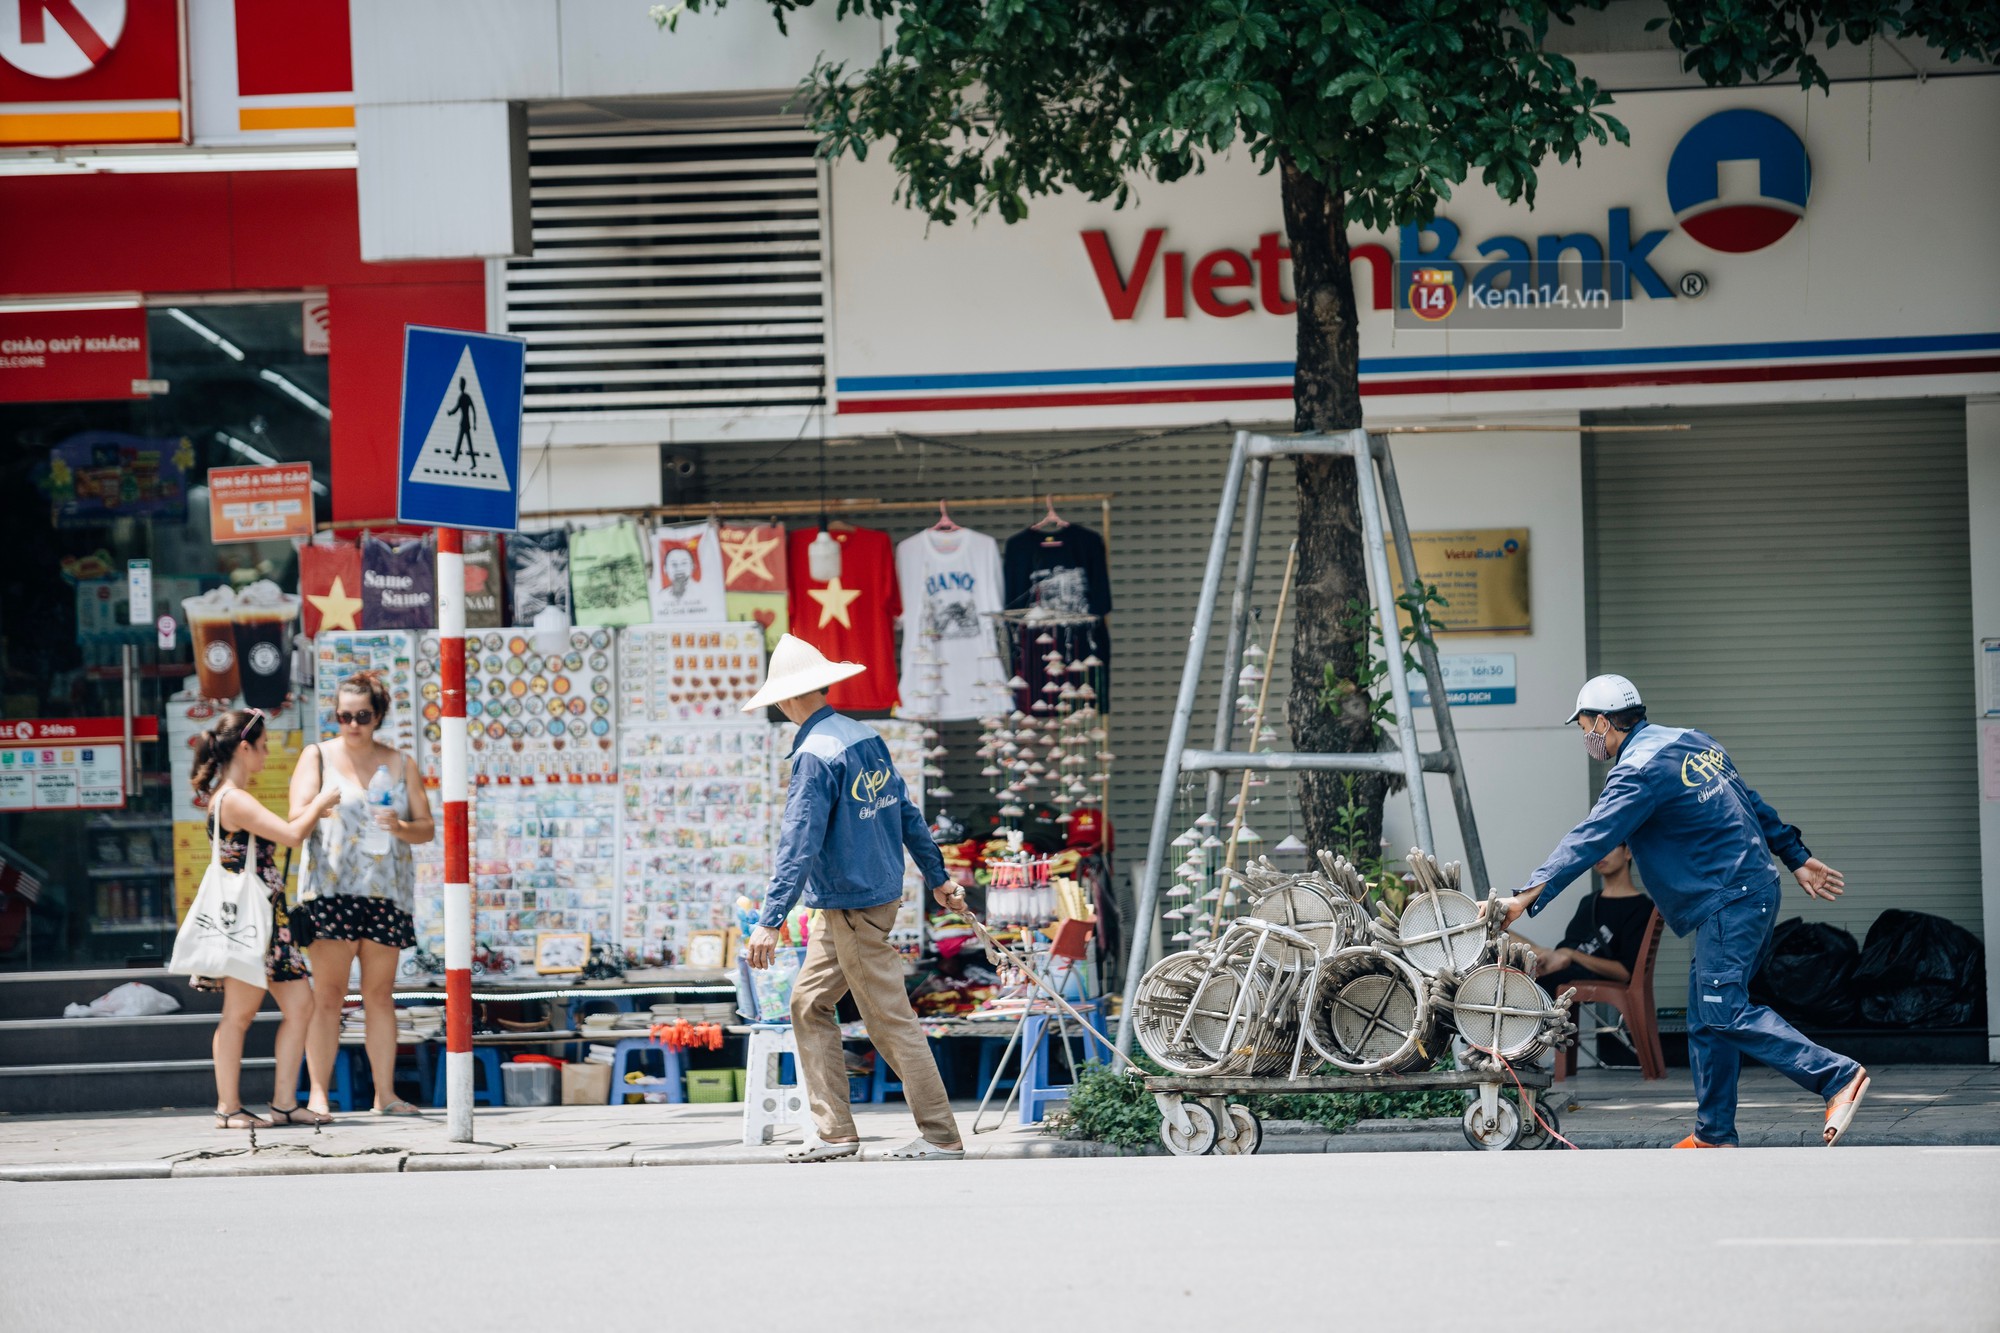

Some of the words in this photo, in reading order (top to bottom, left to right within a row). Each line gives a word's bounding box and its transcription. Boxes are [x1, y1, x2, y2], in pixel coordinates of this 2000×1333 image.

[1080, 207, 1676, 320] VietnBank
[1, 337, 47, 354] CHÀO
[85, 335, 140, 352] KHÁCH
[0, 356, 46, 368] ELCOME
[364, 569, 414, 590] Same
[381, 588, 432, 608] Same
[40, 724, 77, 737] 24hrs
